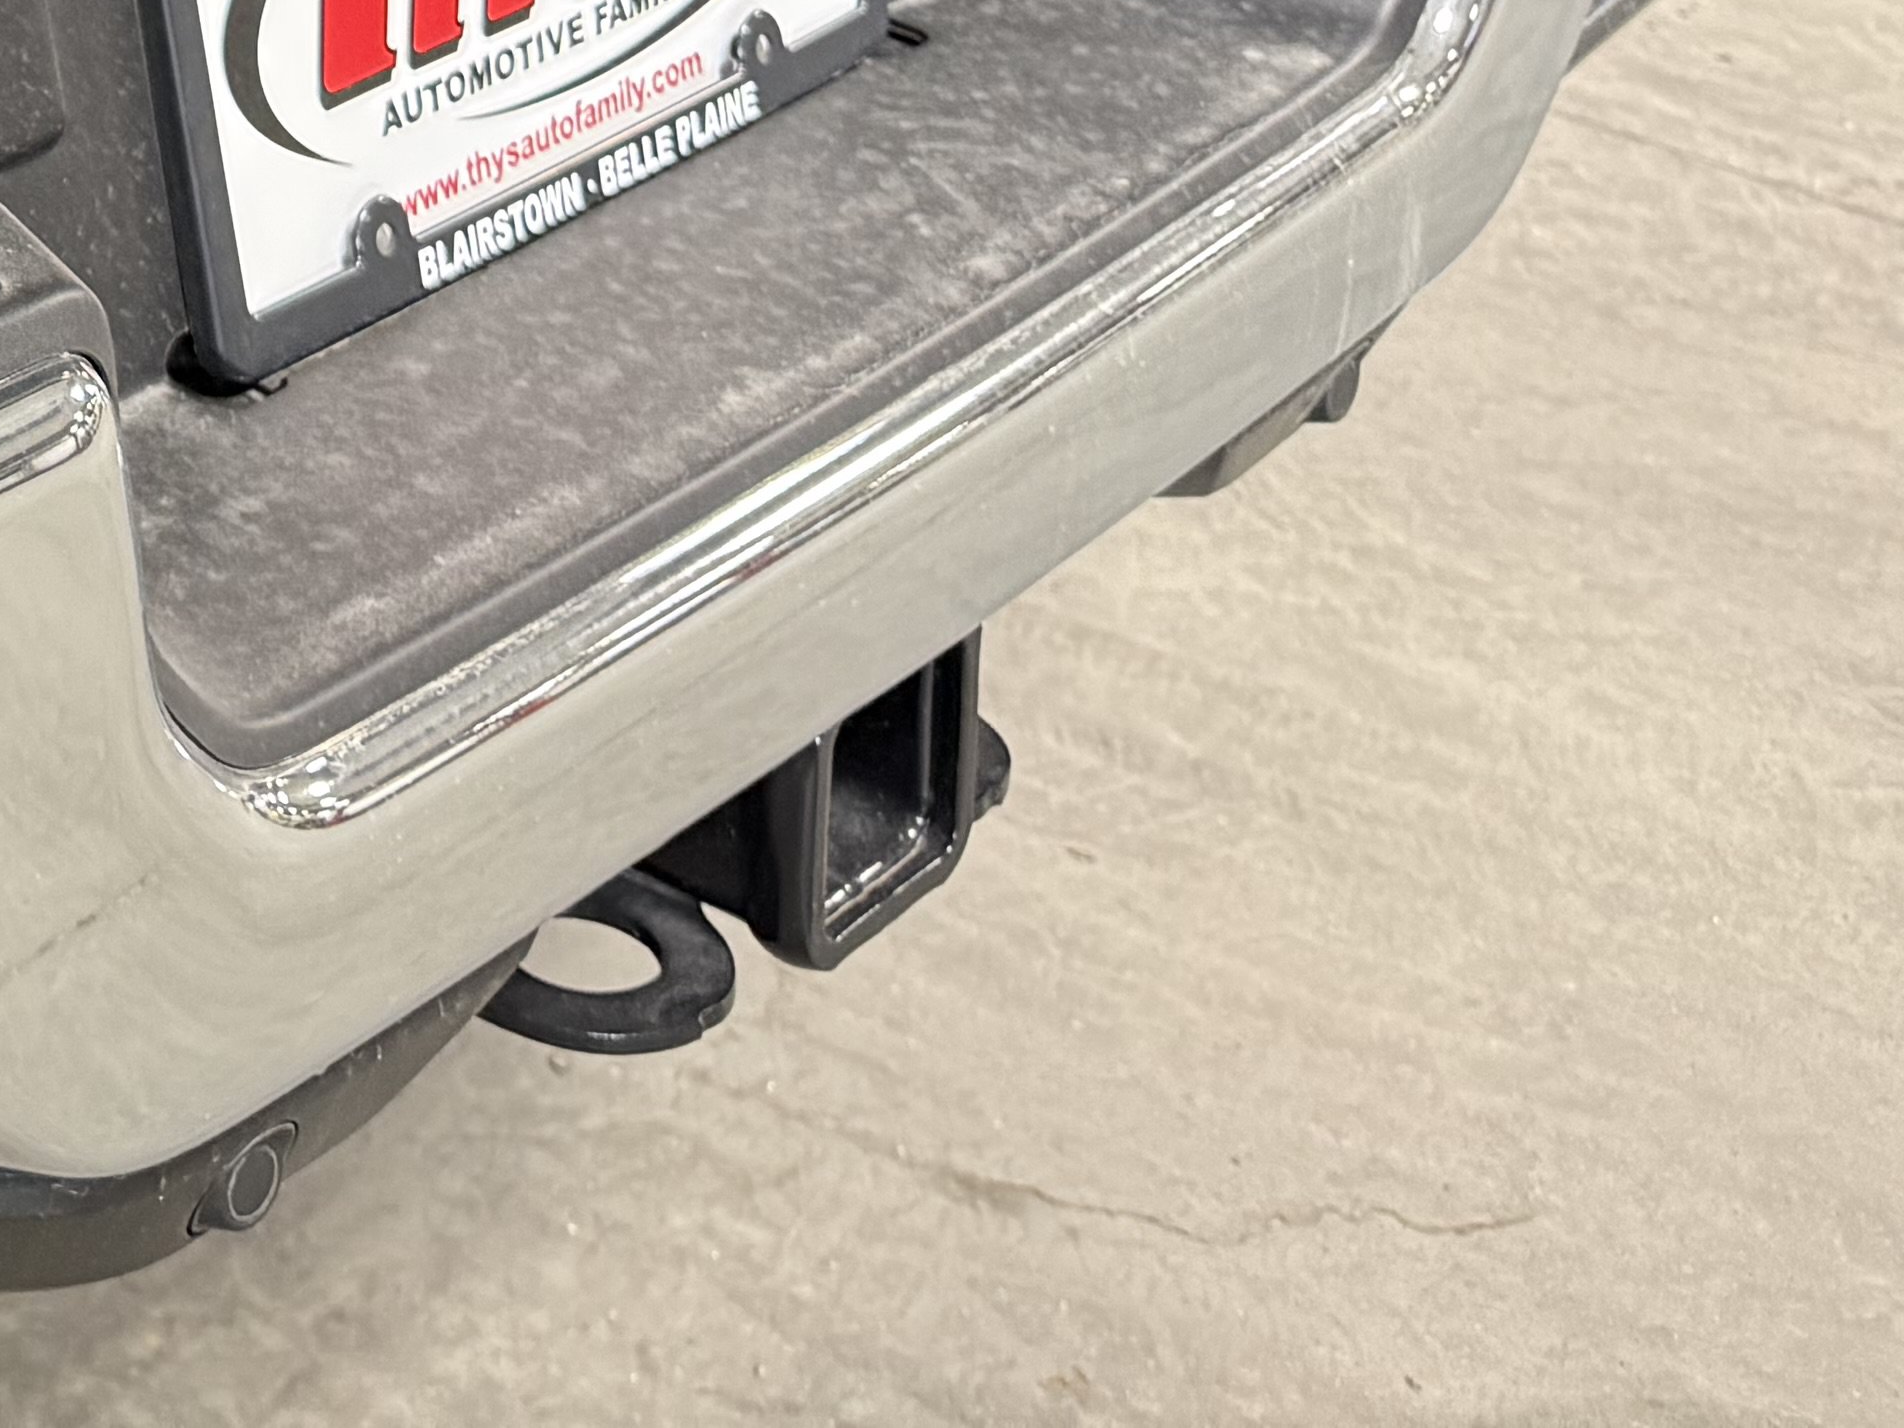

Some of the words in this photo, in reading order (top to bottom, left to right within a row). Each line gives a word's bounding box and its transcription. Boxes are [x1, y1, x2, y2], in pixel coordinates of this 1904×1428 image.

[382, 11, 586, 137] AUTOMOTIVE
[400, 50, 705, 218] www.thysautofamily.com
[417, 171, 588, 291] BLAIRSTOWN
[597, 123, 678, 197] BELLE
[675, 80, 763, 157] PLAINE
